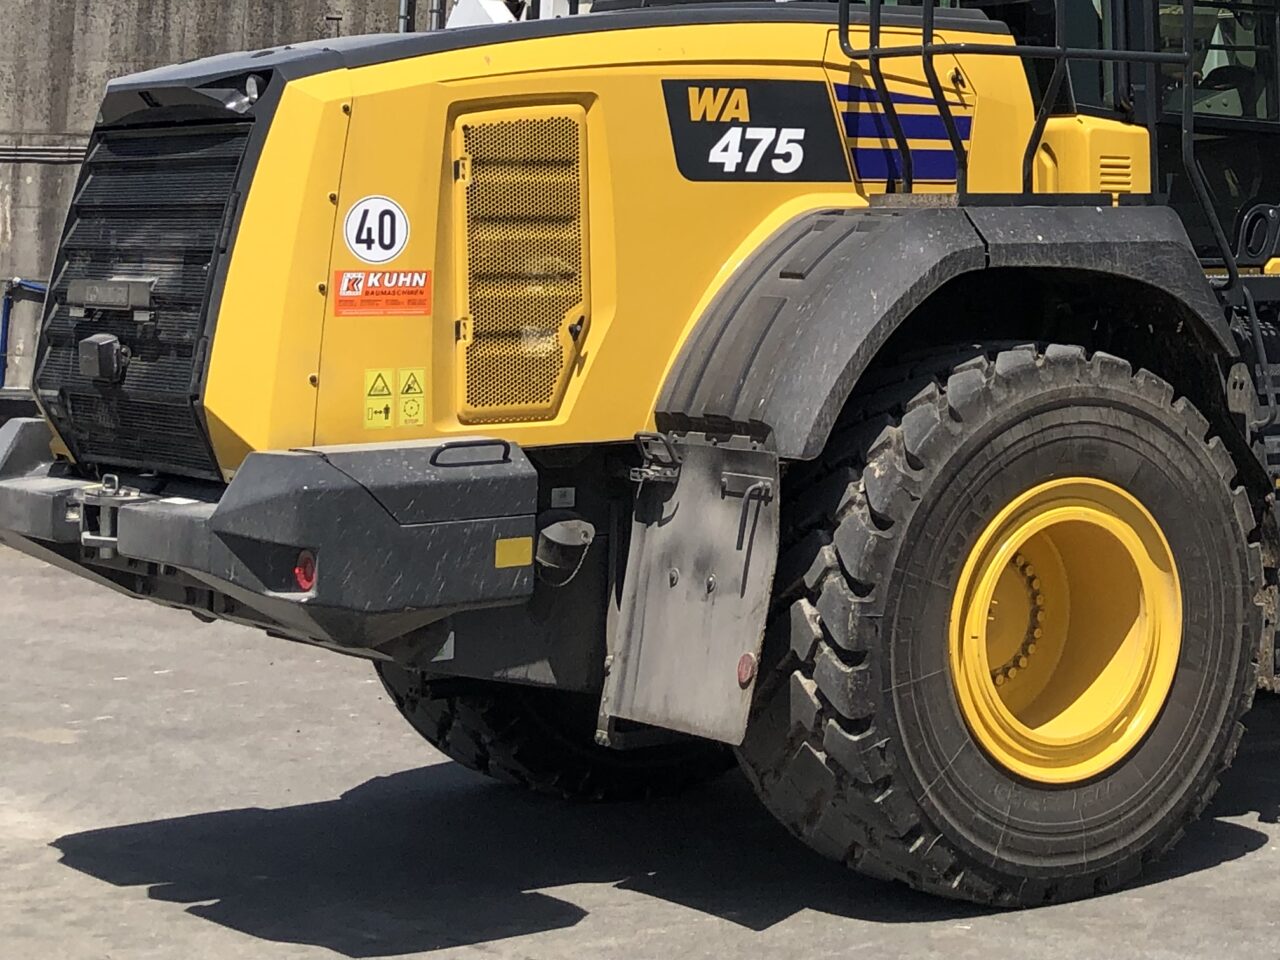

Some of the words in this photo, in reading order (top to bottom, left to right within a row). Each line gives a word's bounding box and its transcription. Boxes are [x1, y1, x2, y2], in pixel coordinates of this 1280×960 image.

[687, 86, 750, 122] WA
[708, 126, 805, 174] 475
[355, 208, 396, 251] 40
[367, 272, 427, 288] KUHN
